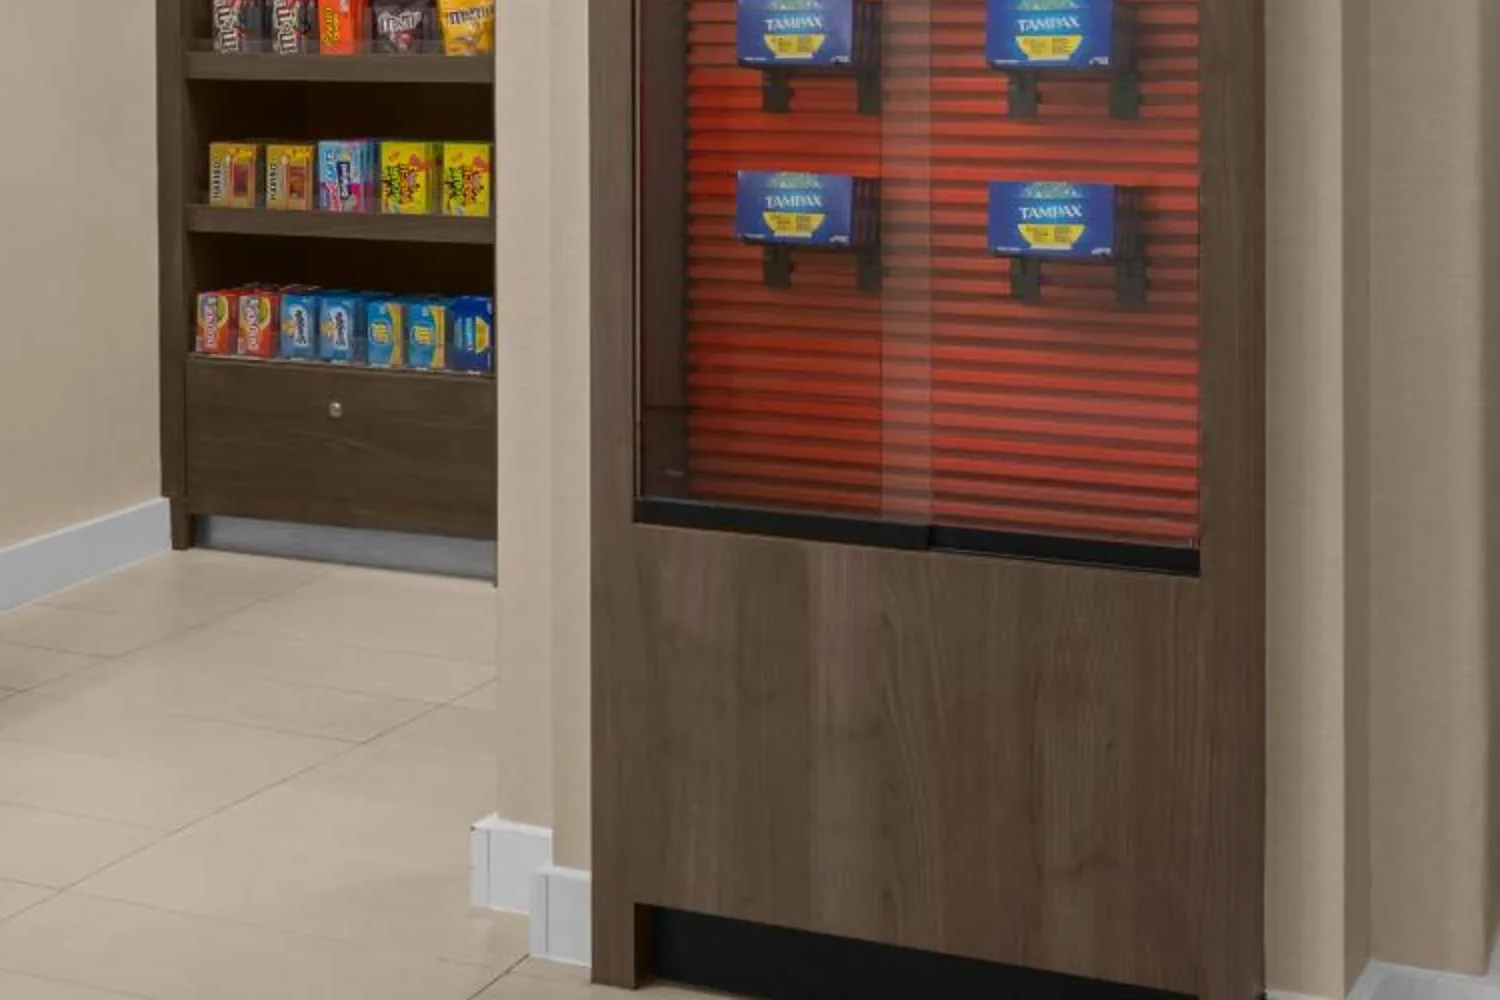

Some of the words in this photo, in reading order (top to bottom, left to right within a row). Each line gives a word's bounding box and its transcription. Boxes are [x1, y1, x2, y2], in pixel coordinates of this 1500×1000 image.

[764, 15, 824, 32] TAMPAX
[1016, 15, 1081, 32] TAMPAX
[764, 194, 823, 210] TAMPAX
[1018, 204, 1084, 220] TAMPAX
